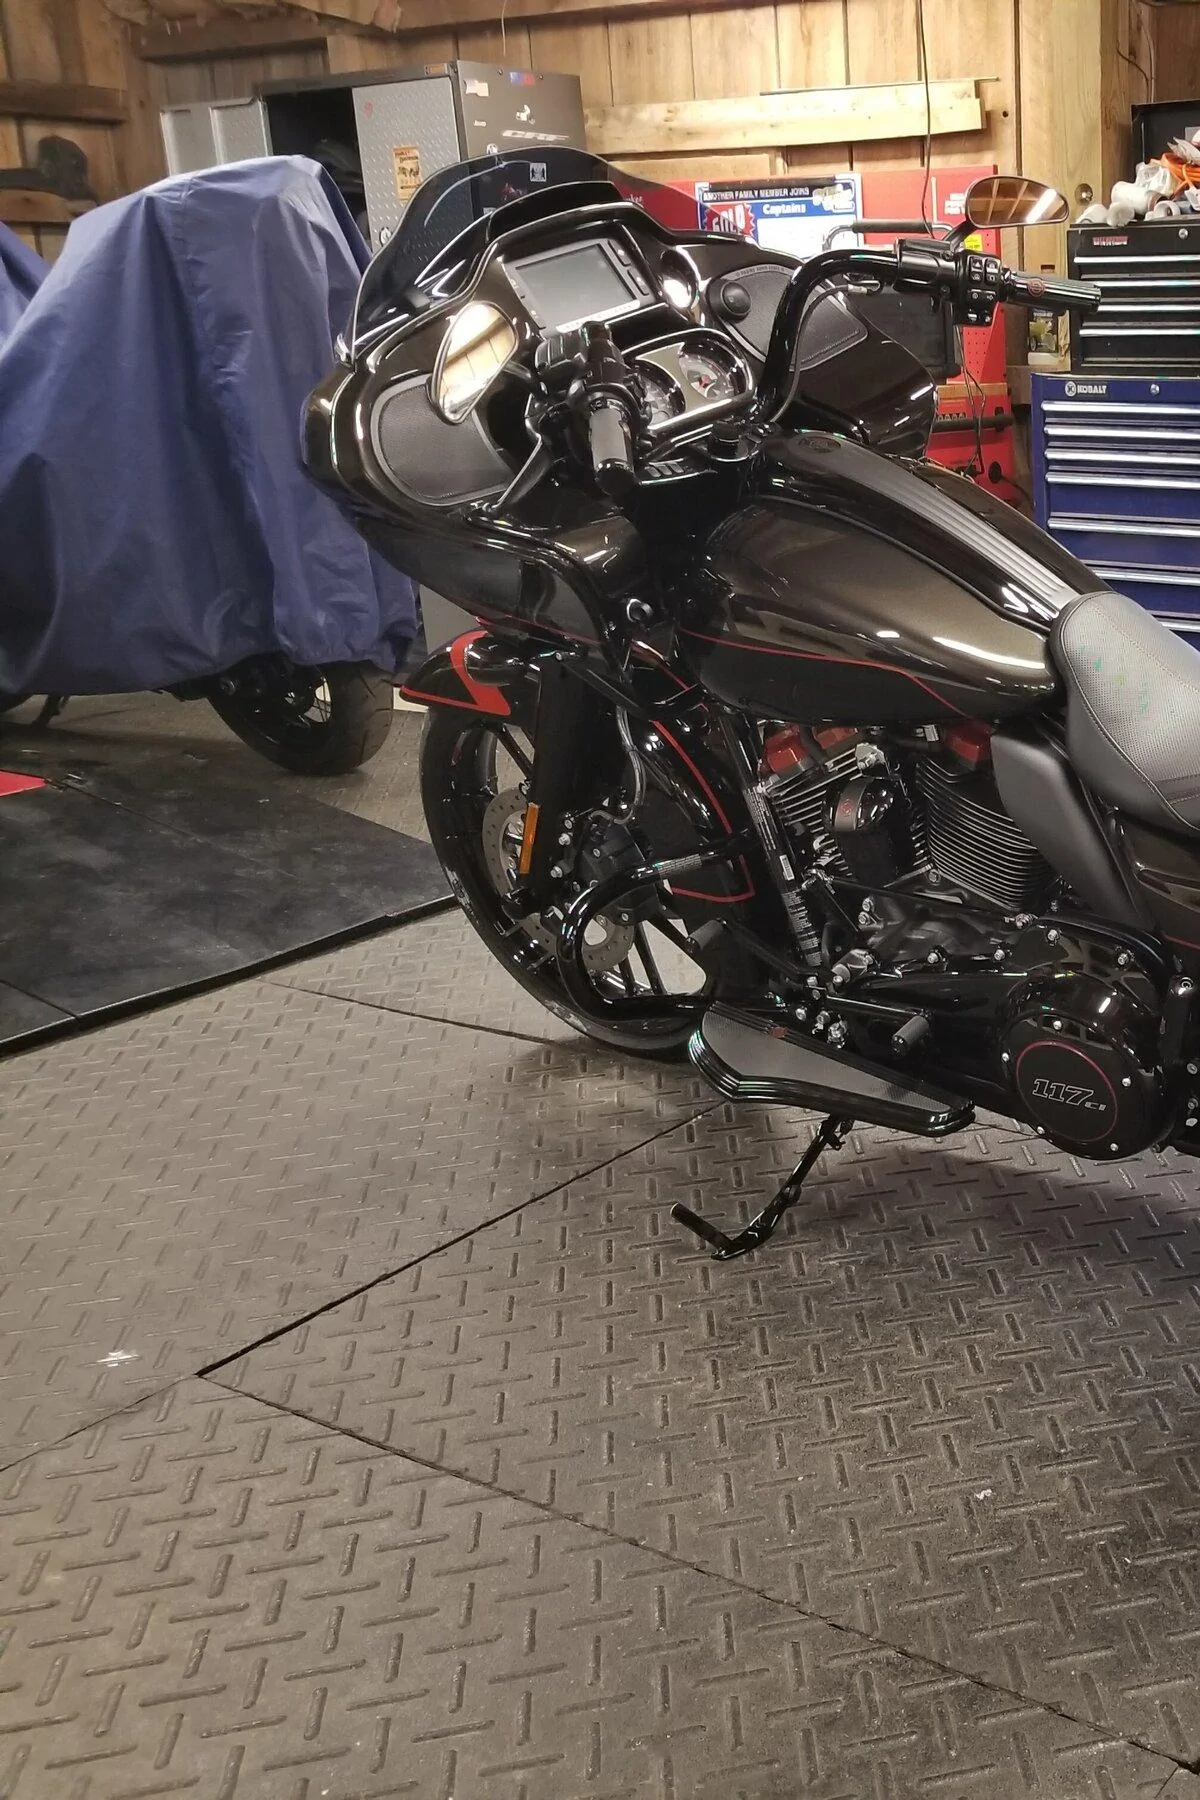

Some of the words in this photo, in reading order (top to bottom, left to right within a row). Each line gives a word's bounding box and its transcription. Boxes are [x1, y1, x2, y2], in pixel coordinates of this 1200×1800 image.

[703, 191, 734, 201] ANOTHER
[734, 189, 759, 200] FAMILY
[760, 188, 788, 198] MEMBER
[789, 187, 810, 197] JOINS
[762, 203, 806, 217] Captains
[1077, 385, 1107, 395] KOBALT
[1032, 1078, 1094, 1106] 117
